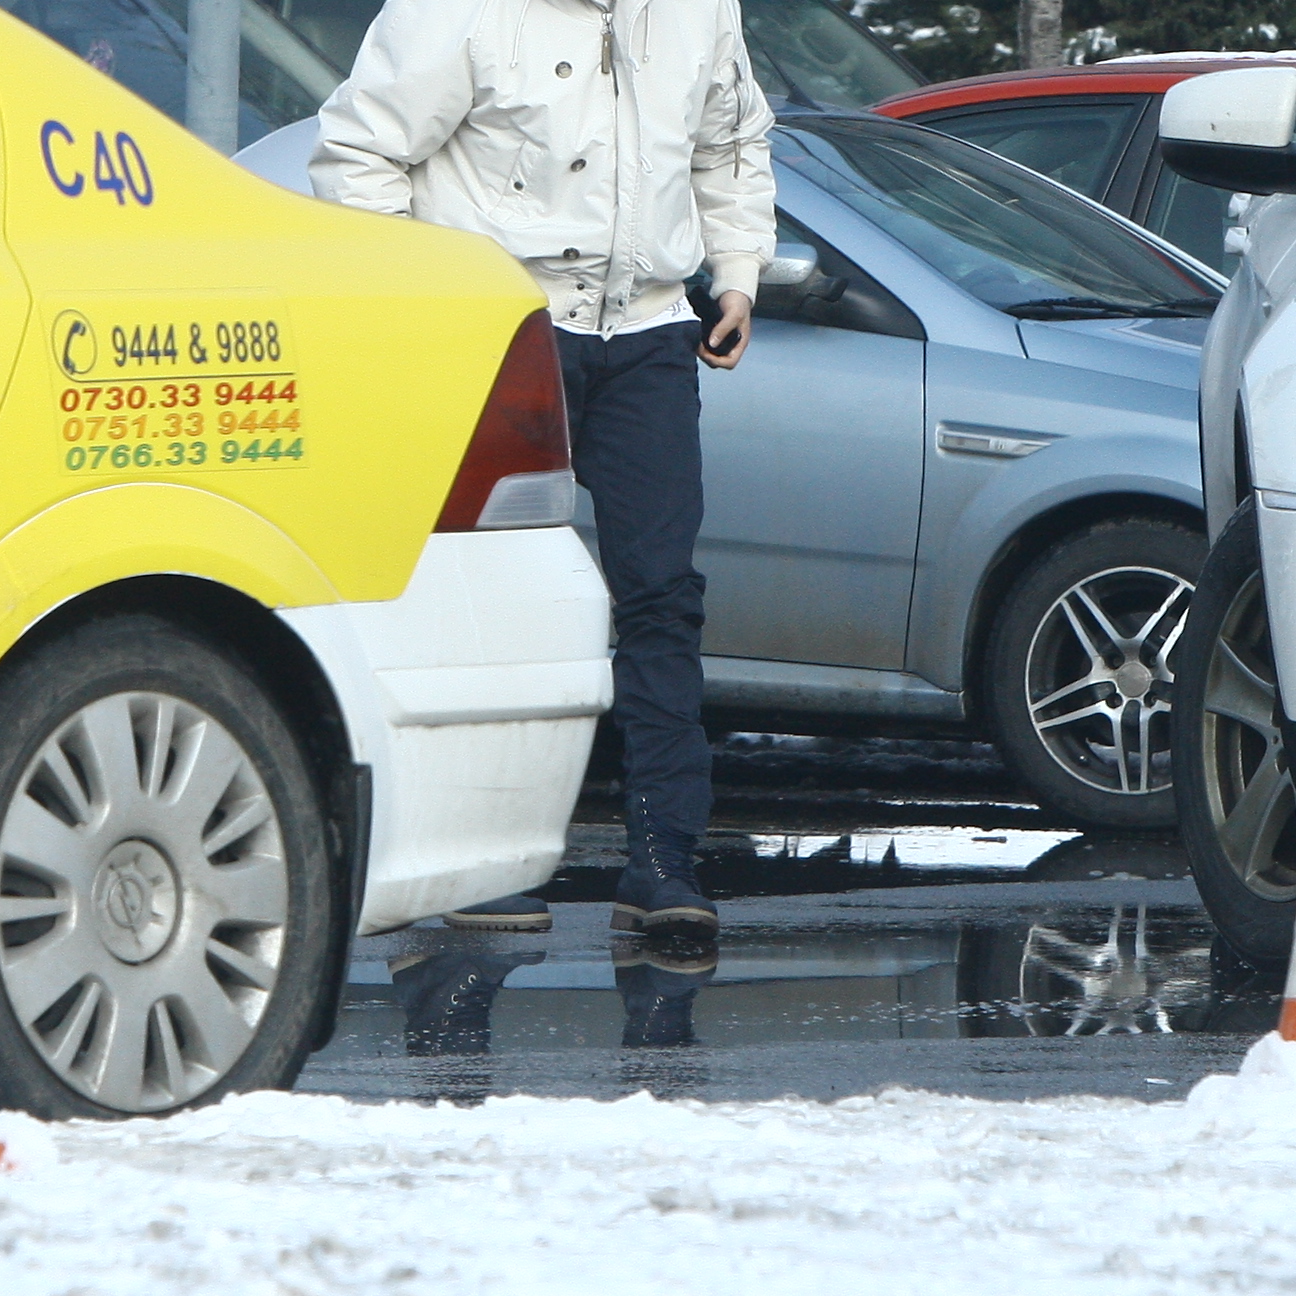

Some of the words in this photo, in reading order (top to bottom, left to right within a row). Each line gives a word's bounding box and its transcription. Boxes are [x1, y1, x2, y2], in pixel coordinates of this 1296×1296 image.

[112, 324, 178, 367] 9444
[189, 322, 207, 364] &
[216, 320, 281, 363] 9888
[60, 383, 201, 412] 0730.33
[214, 380, 298, 407] 9444
[62, 412, 205, 442] 0751.33
[217, 408, 301, 435] 9444
[65, 441, 207, 471] 0766.33
[220, 437, 304, 464] 9444
